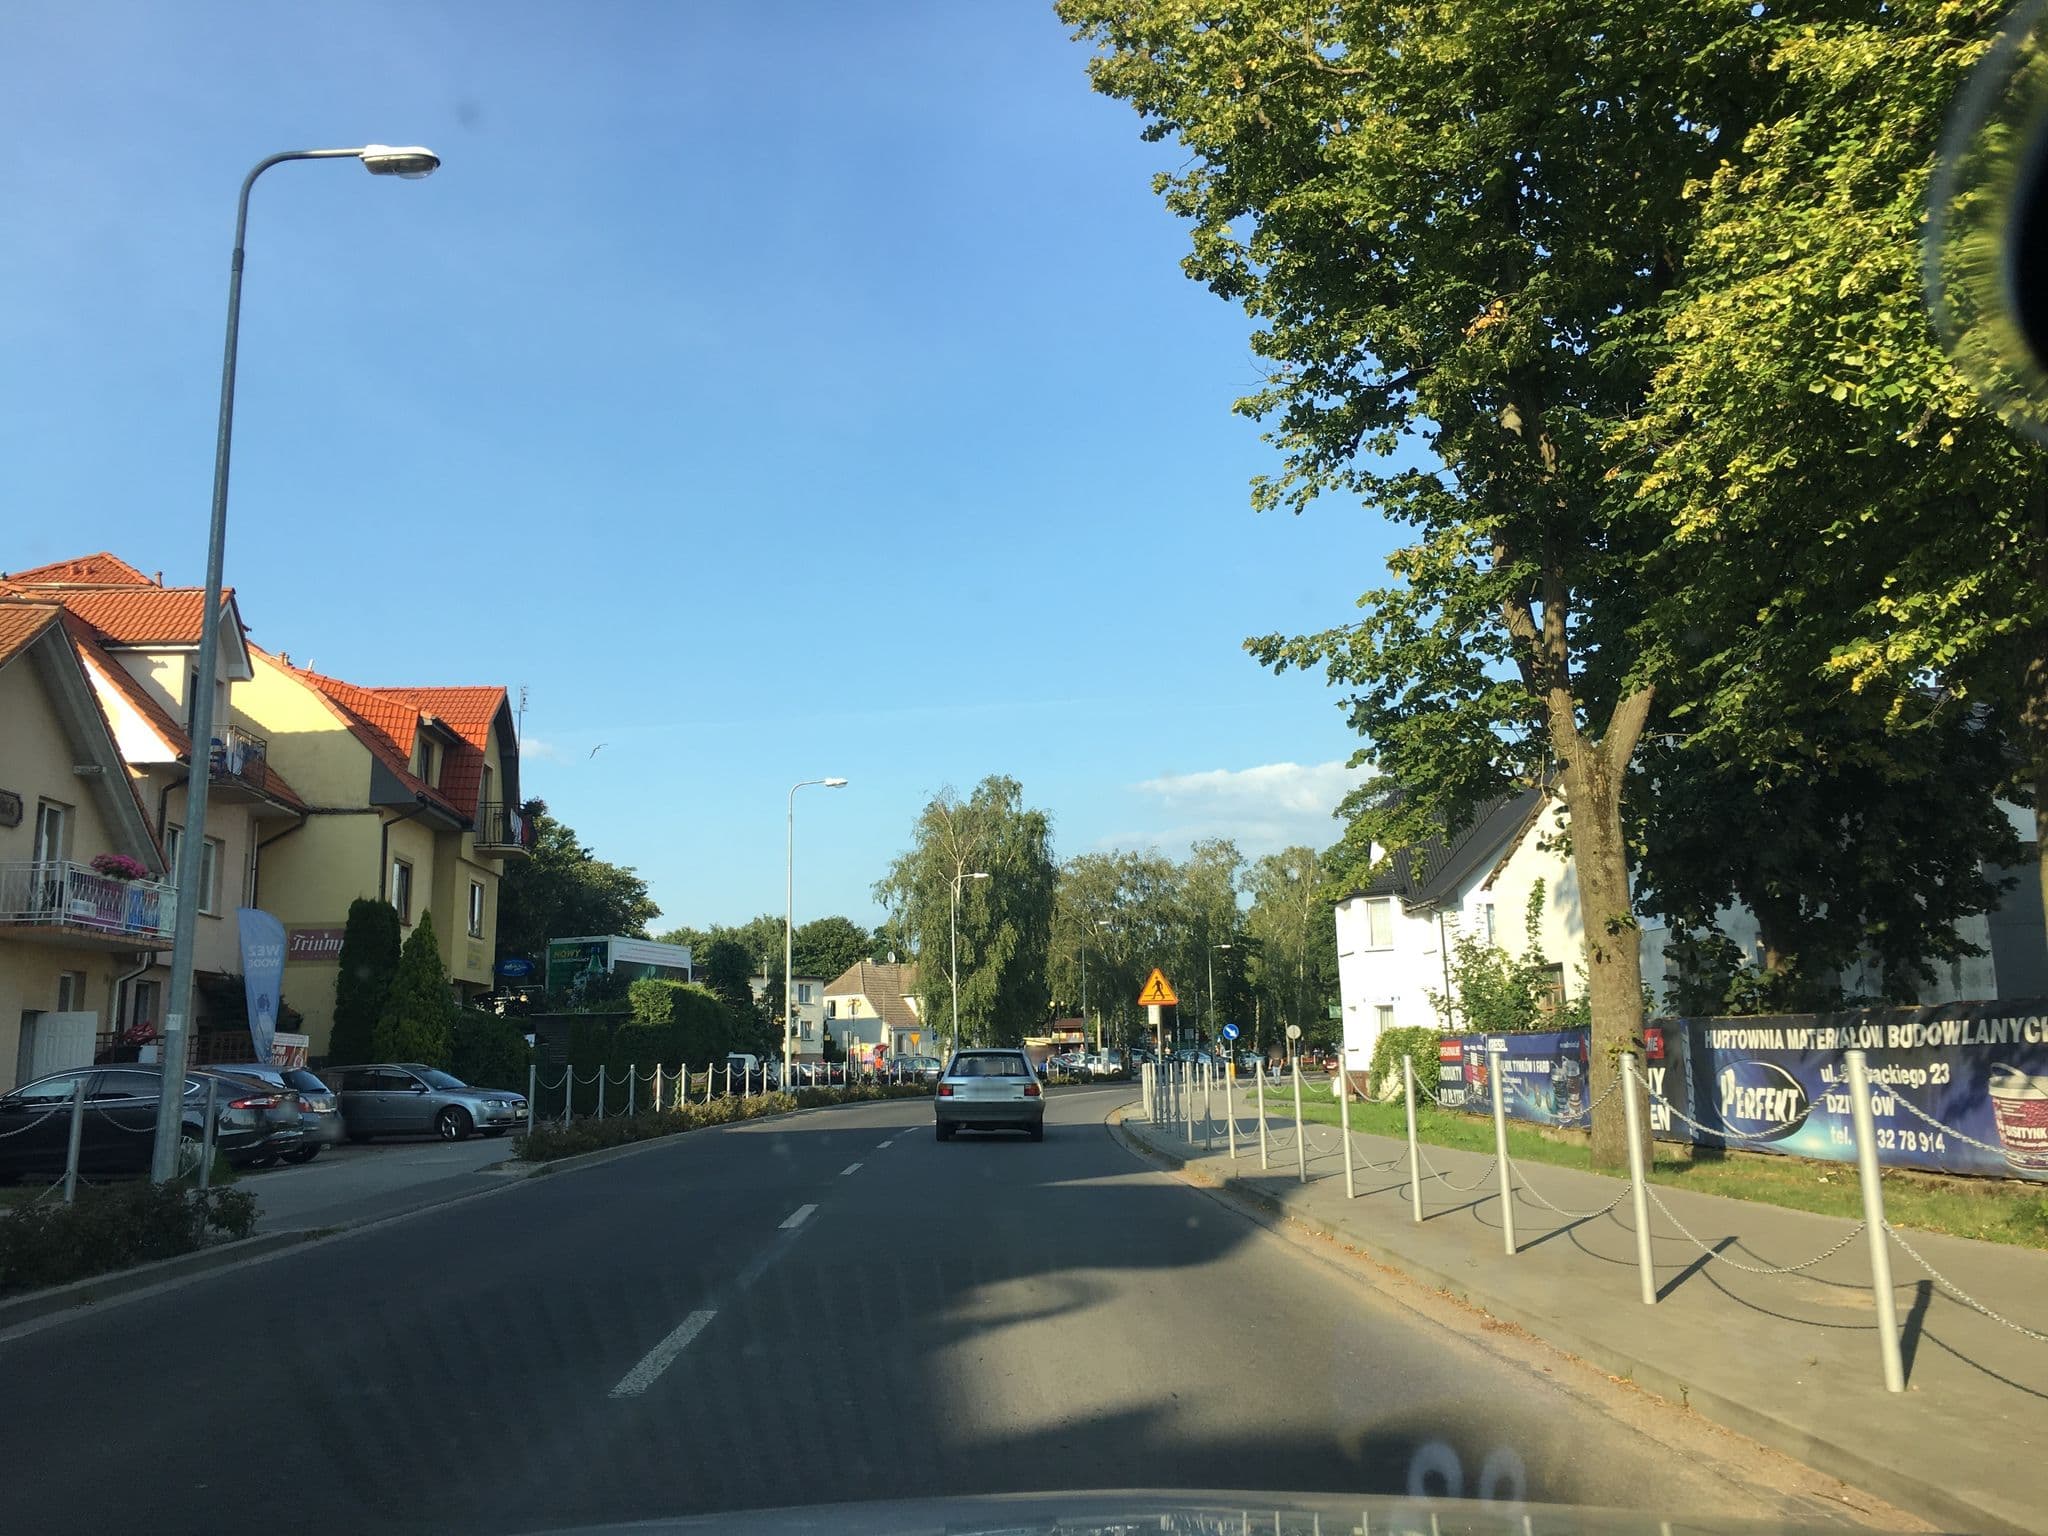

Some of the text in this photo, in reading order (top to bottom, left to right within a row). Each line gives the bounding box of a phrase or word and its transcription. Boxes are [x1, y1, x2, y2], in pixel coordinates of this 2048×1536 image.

[1705, 1029, 1784, 1049] HURTOWNIA
[1786, 1019, 1884, 1050] MATERIAŁÓW
[1820, 1064, 1837, 1083] ul.
[1930, 1063, 1950, 1084] 23
[1720, 1068, 1799, 1123] PERFEKT
[1827, 1092, 1895, 1117] DZIÓW
[1877, 1129, 1895, 1149] 32
[1898, 1130, 1917, 1151] 78
[1919, 1132, 1945, 1153] 914
